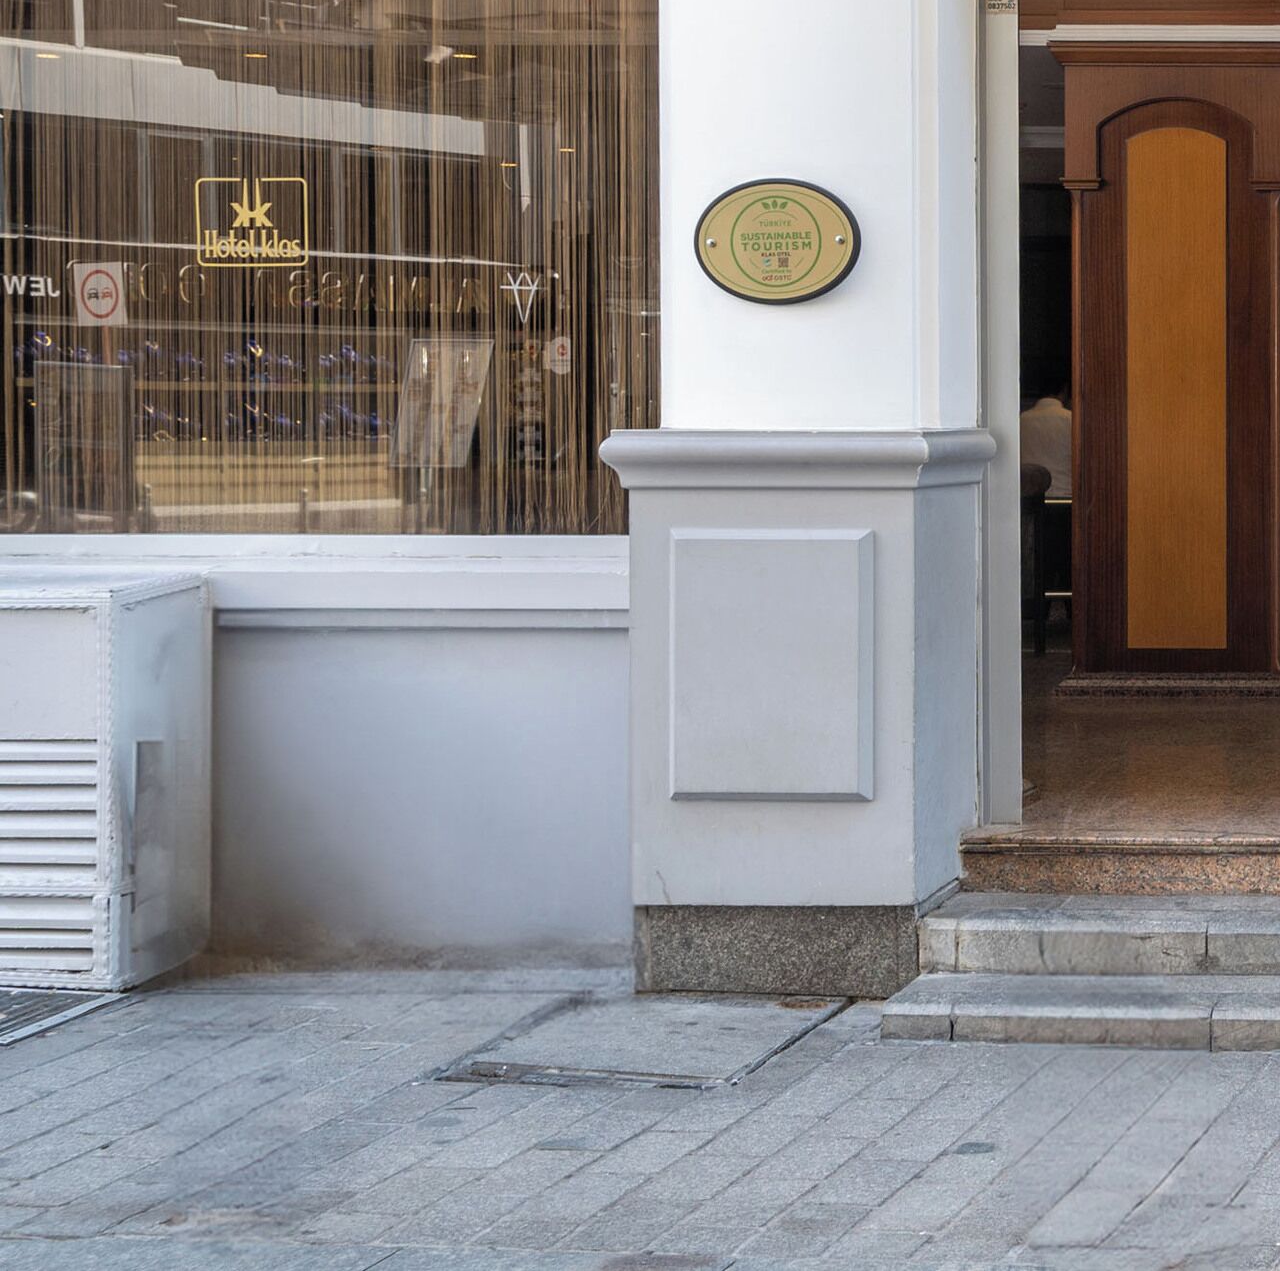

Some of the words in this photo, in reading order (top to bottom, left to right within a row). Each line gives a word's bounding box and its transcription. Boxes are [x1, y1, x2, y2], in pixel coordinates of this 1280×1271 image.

[740, 231, 812, 241] SUSTAINABLE
[204, 229, 259, 259] Hotel
[261, 229, 301, 258] klas
[741, 241, 812, 251] TOURISM
